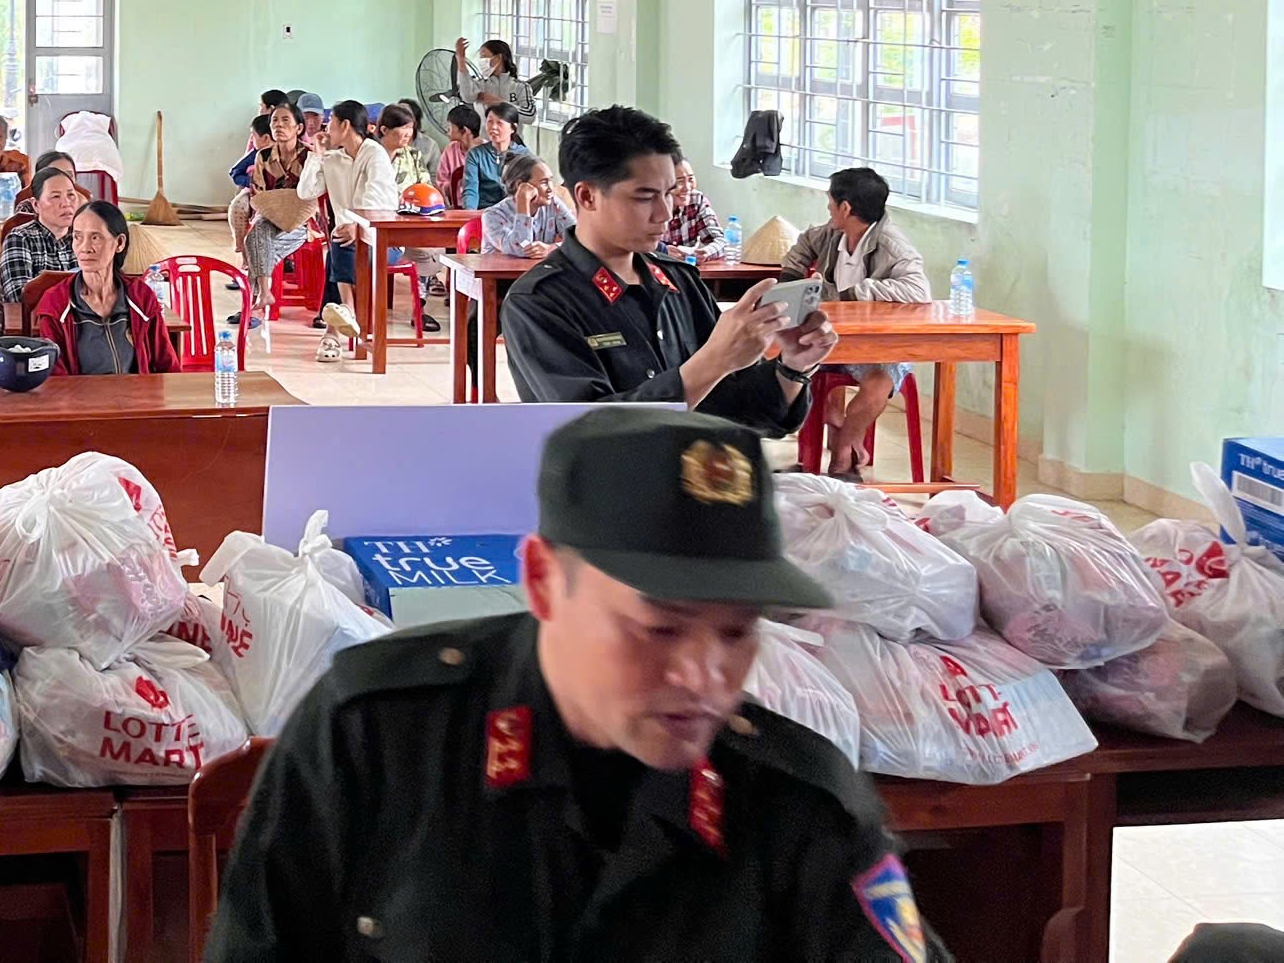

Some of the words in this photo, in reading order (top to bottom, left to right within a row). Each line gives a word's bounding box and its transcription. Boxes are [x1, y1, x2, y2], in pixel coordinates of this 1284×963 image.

[364, 540, 431, 554] TH
[372, 554, 496, 572] true
[388, 569, 512, 585] MILK
[103, 711, 201, 743] LOTTE
[99, 736, 205, 771] MART
